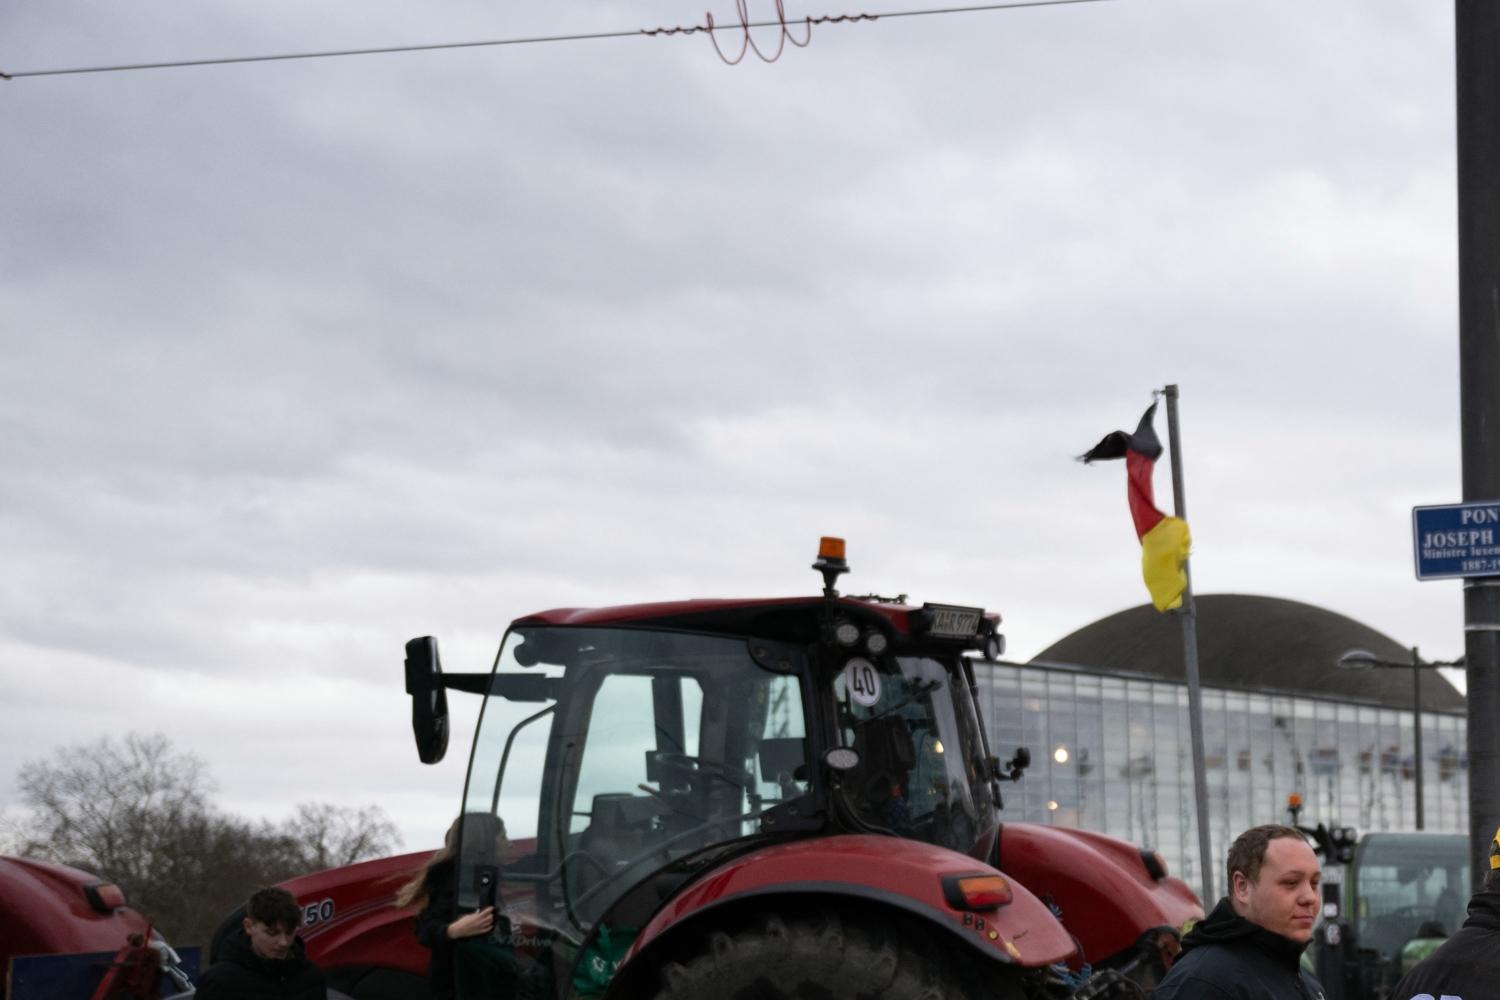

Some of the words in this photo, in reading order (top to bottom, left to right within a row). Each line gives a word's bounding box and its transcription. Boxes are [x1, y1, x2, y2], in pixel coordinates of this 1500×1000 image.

[1423, 530, 1493, 547] JOSEPH
[1423, 548, 1466, 559] Ministre
[852, 666, 875, 696] 40
[301, 898, 335, 926] 50
